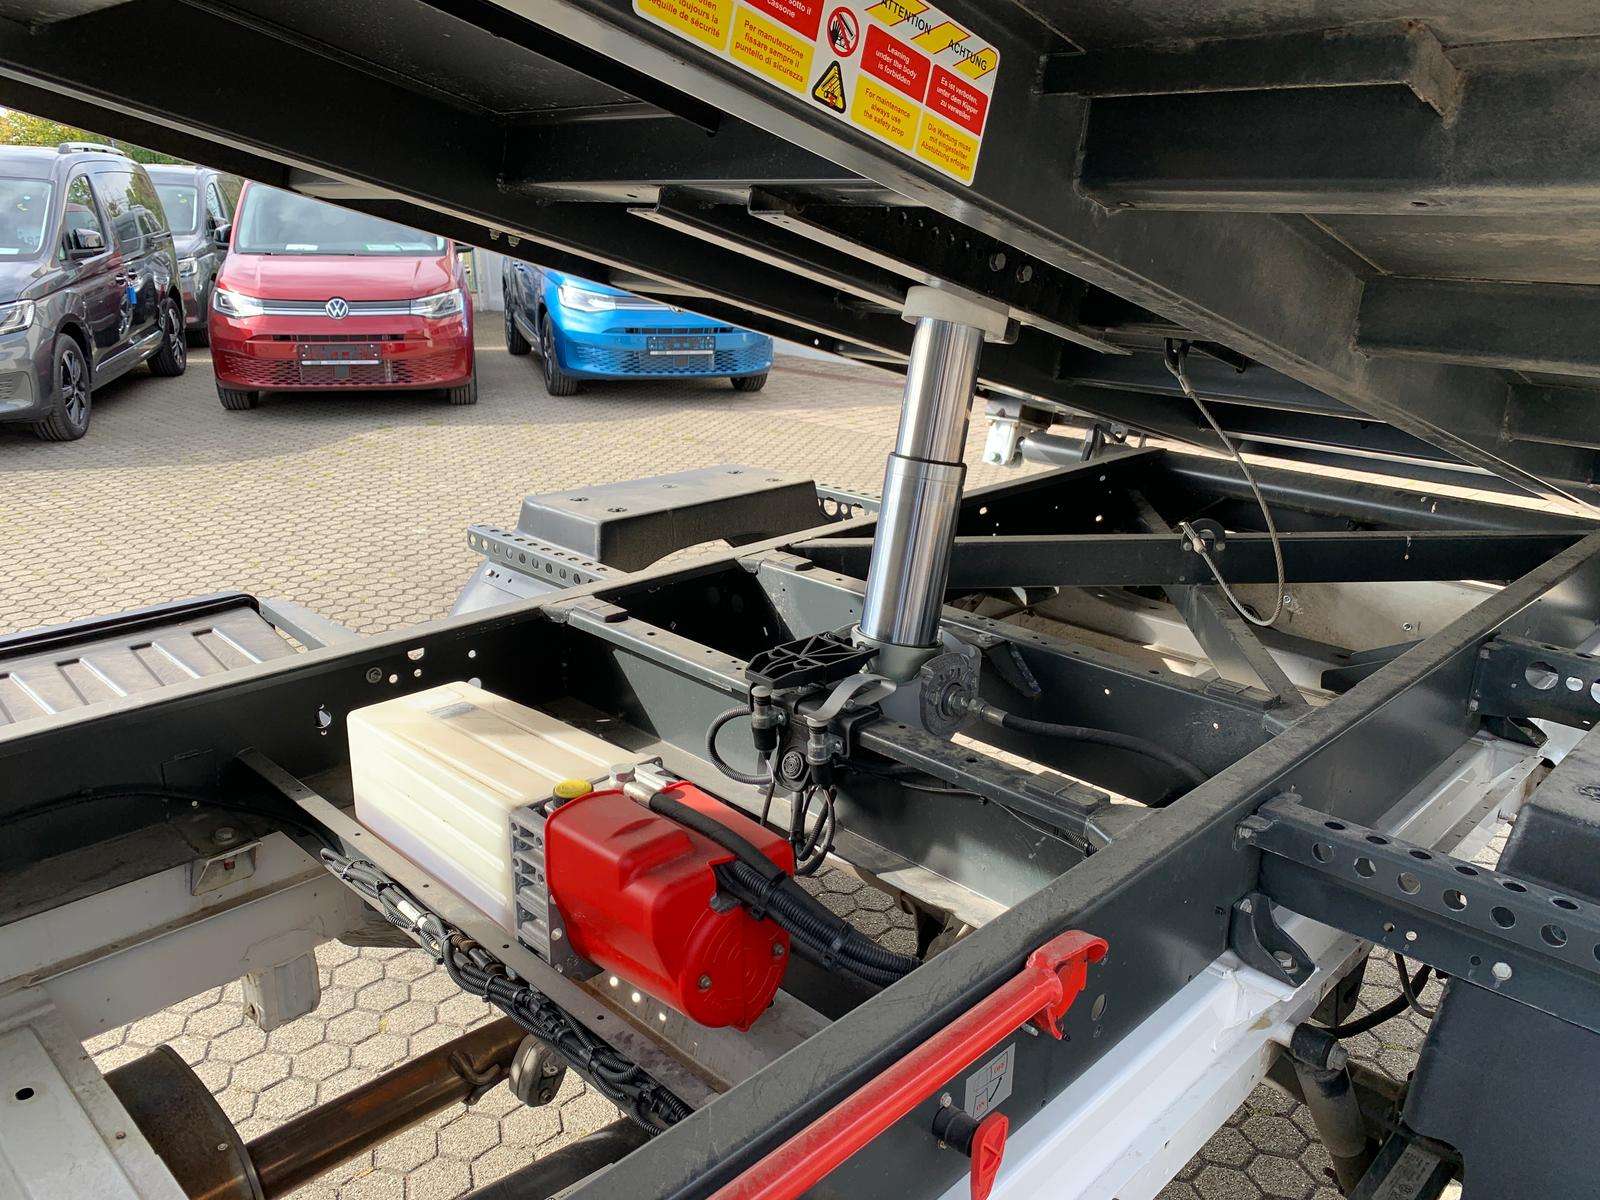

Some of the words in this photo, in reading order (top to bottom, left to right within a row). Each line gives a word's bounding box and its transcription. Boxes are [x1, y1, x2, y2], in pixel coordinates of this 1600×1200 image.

[679, 11, 689, 21] de
[690, 17, 720, 37] sécurité
[881, 0, 932, 35] ATTENTION
[744, 20, 756, 31] Per
[757, 28, 804, 59] manutenzione
[744, 33, 768, 51] fissare
[769, 47, 794, 66] sempre
[887, 44, 910, 65] Leaning
[735, 41, 764, 61] puntello
[772, 61, 803, 83] sicurezza
[875, 50, 892, 65] under
[893, 59, 902, 69] the
[902, 64, 917, 80] body
[948, 39, 987, 71] ACHTUNG
[884, 66, 911, 86] forbidden
[865, 88, 876, 99] For
[876, 94, 911, 118] maintenance
[871, 103, 890, 119] always
[890, 113, 902, 124] use
[864, 111, 873, 121] the
[873, 116, 891, 131] safety
[891, 126, 905, 138] prop
